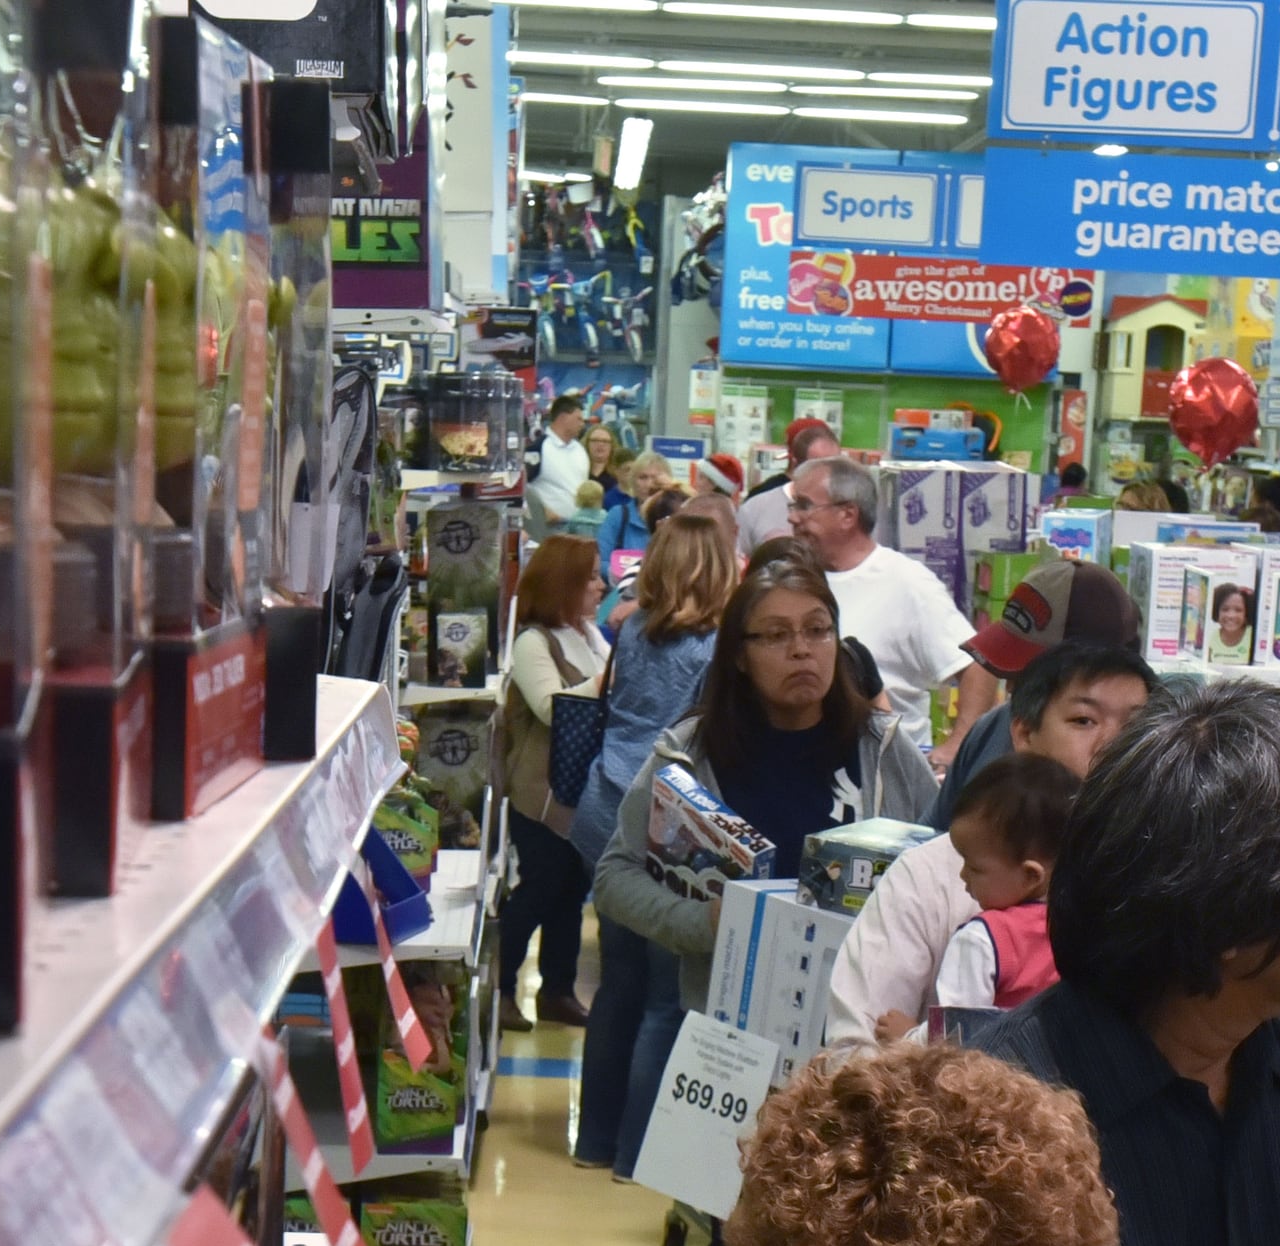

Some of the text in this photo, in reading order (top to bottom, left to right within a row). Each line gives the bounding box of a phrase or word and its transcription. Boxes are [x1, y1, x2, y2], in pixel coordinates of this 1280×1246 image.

[1056, 11, 1209, 59] Action
[1043, 66, 1218, 122] Figures
[1072, 170, 1172, 214] price
[822, 190, 914, 223] Sports
[739, 266, 773, 283] plus,
[738, 287, 785, 311] free
[854, 274, 1027, 302] awesome!
[738, 318, 876, 337] when you buy online
[386, 1095, 447, 1110] TURTLES
[394, 1088, 433, 1099] NINJA
[671, 1072, 749, 1124] $69.99
[385, 1221, 440, 1233] NINJA
